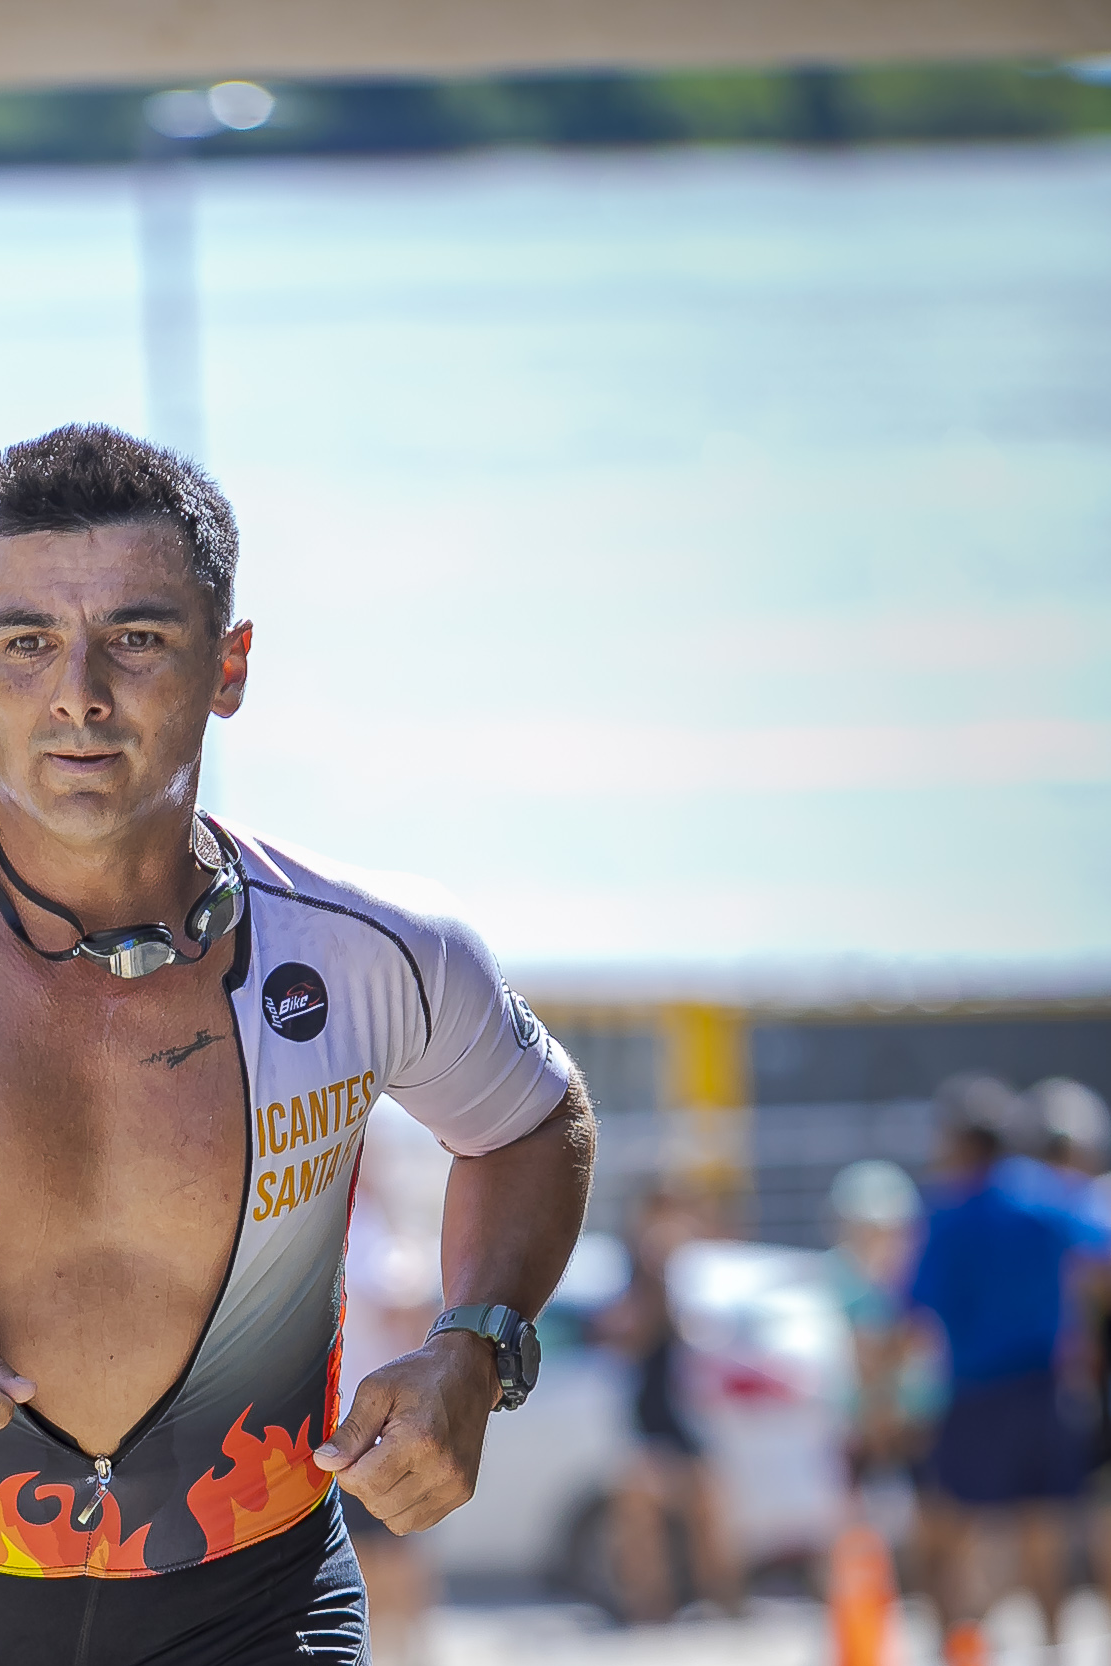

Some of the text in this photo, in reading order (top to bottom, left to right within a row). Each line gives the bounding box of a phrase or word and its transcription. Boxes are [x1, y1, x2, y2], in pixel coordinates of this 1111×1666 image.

[264, 995, 309, 1028] Indu Bike
[256, 1070, 375, 1158] ICANTES
[252, 1141, 343, 1222] SANTA
